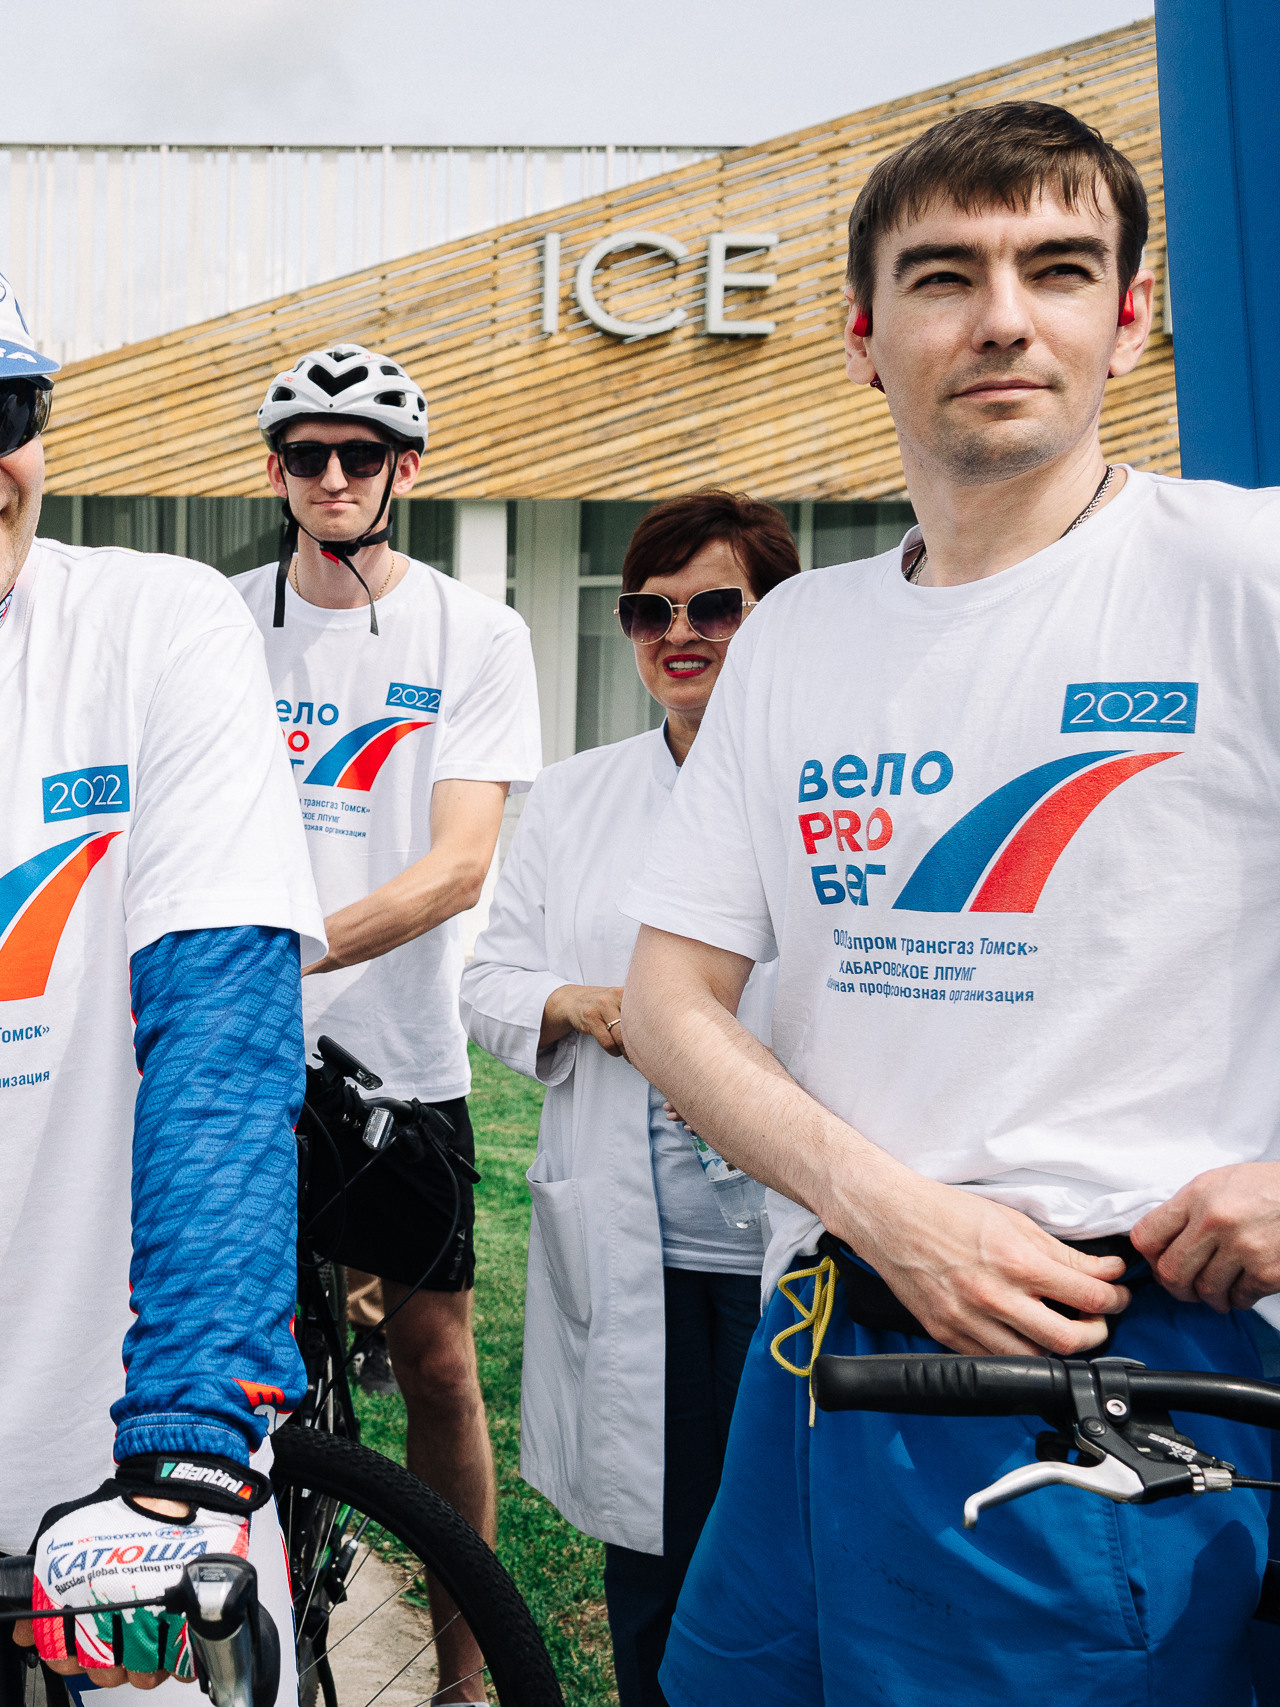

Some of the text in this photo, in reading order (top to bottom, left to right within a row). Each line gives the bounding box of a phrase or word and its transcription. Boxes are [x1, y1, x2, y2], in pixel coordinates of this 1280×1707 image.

[542, 231, 779, 336] ICE
[276, 699, 339, 726] ело
[389, 686, 441, 709] 2022
[1069, 690, 1188, 725] 2022
[49, 773, 123, 814] 2022
[798, 807, 893, 855] PRO
[901, 937, 974, 955] трансгаз
[980, 938, 1039, 956] Томск»
[839, 960, 976, 982] ХАБАРОВСКОЕ ЛПУМГ
[949, 988, 1034, 1004] организация
[170, 1462, 244, 1494] Santini
[47, 1540, 209, 1586] КАТЮША
[55, 1575, 86, 1596] Russian
[87, 1567, 119, 1584] global
[122, 1563, 161, 1576] cycling
